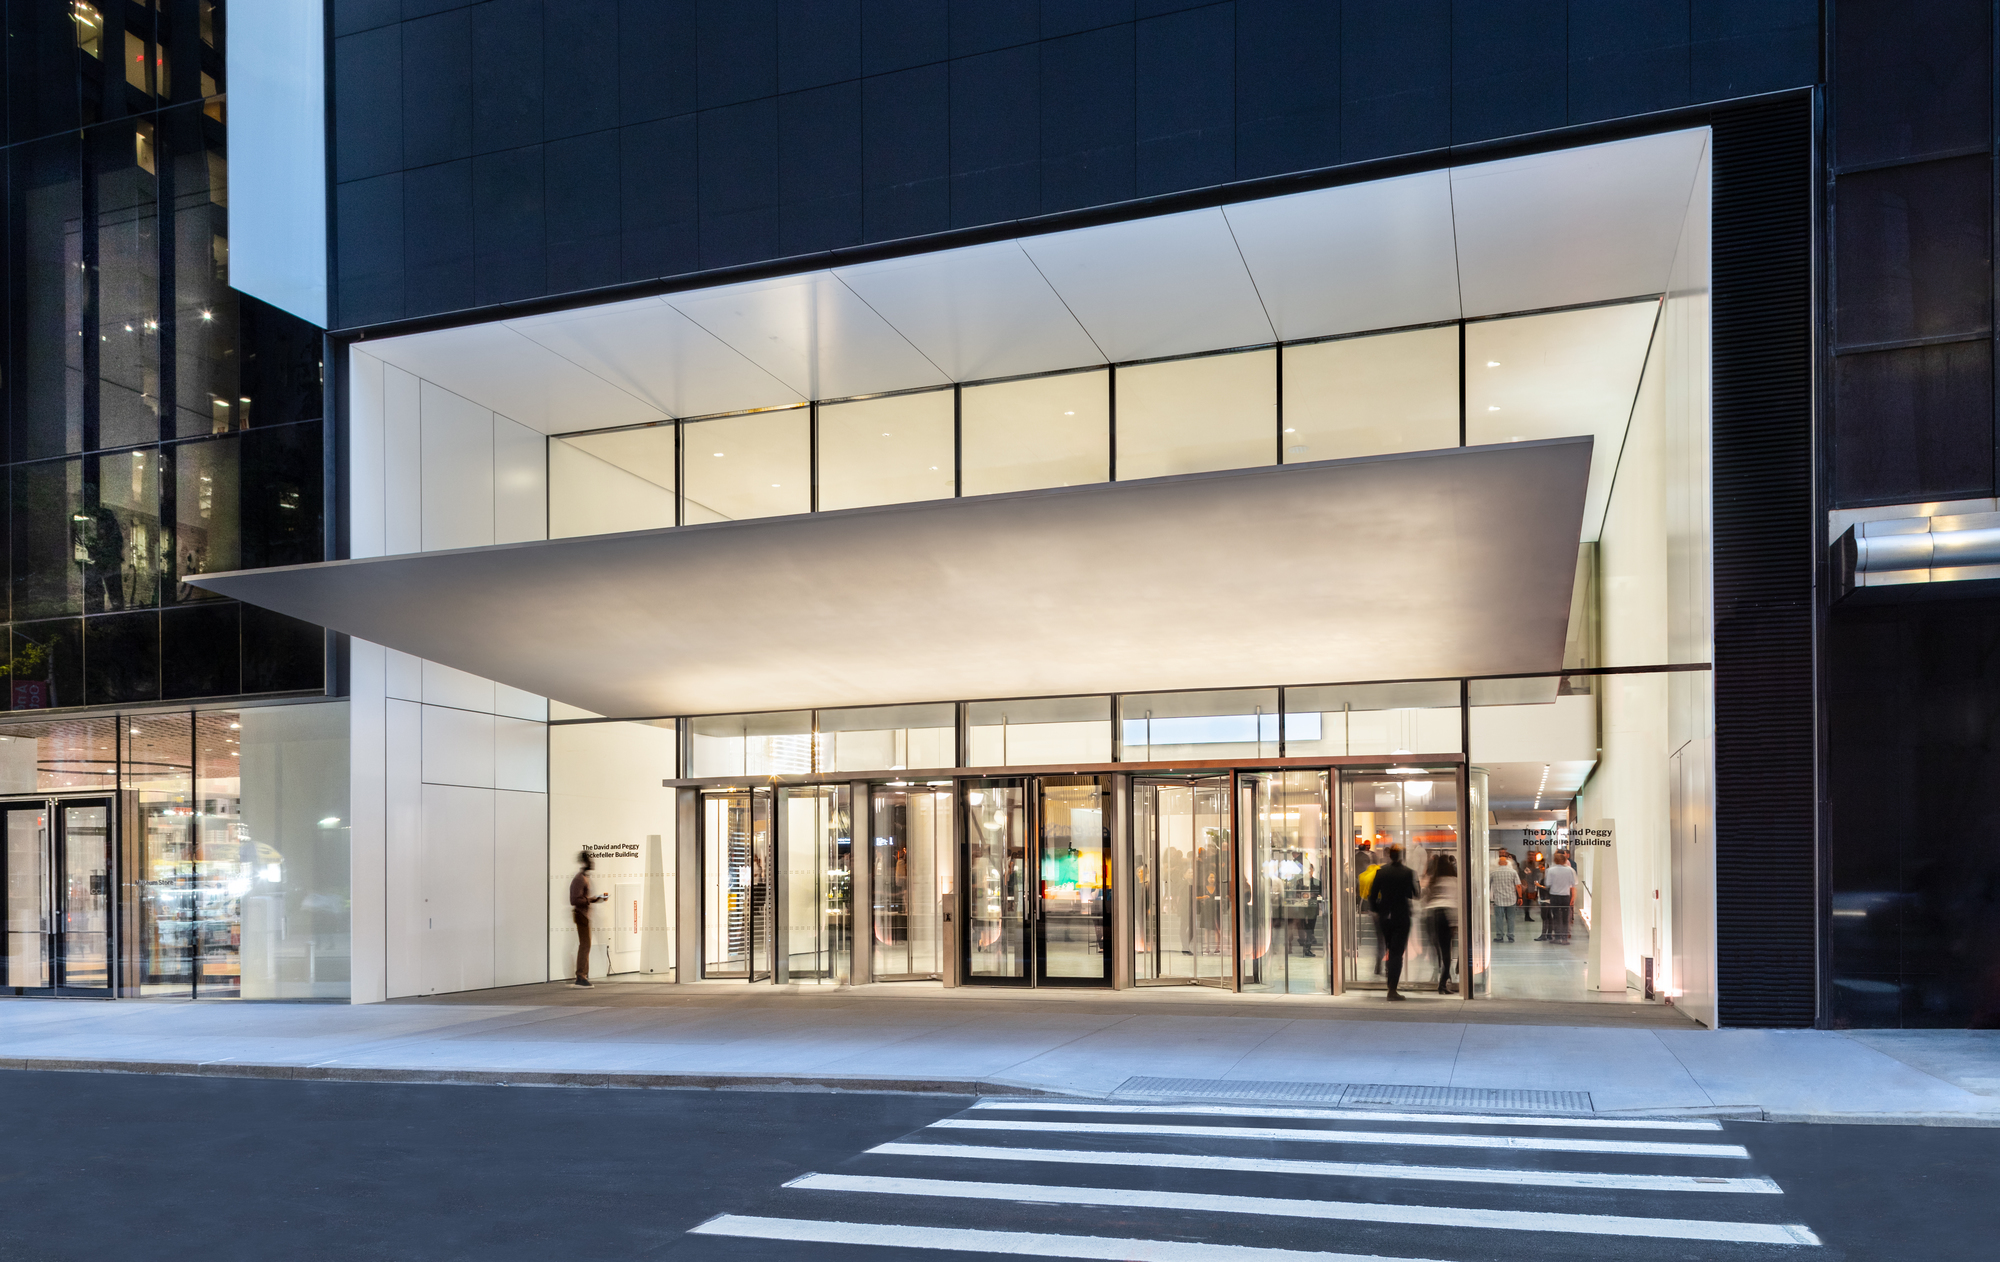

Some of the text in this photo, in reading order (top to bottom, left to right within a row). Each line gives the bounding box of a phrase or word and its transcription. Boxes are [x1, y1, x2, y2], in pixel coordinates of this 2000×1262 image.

[1585, 828, 1612, 837] Peggy
[622, 843, 639, 851] Peggy
[1574, 839, 1611, 847] Building
